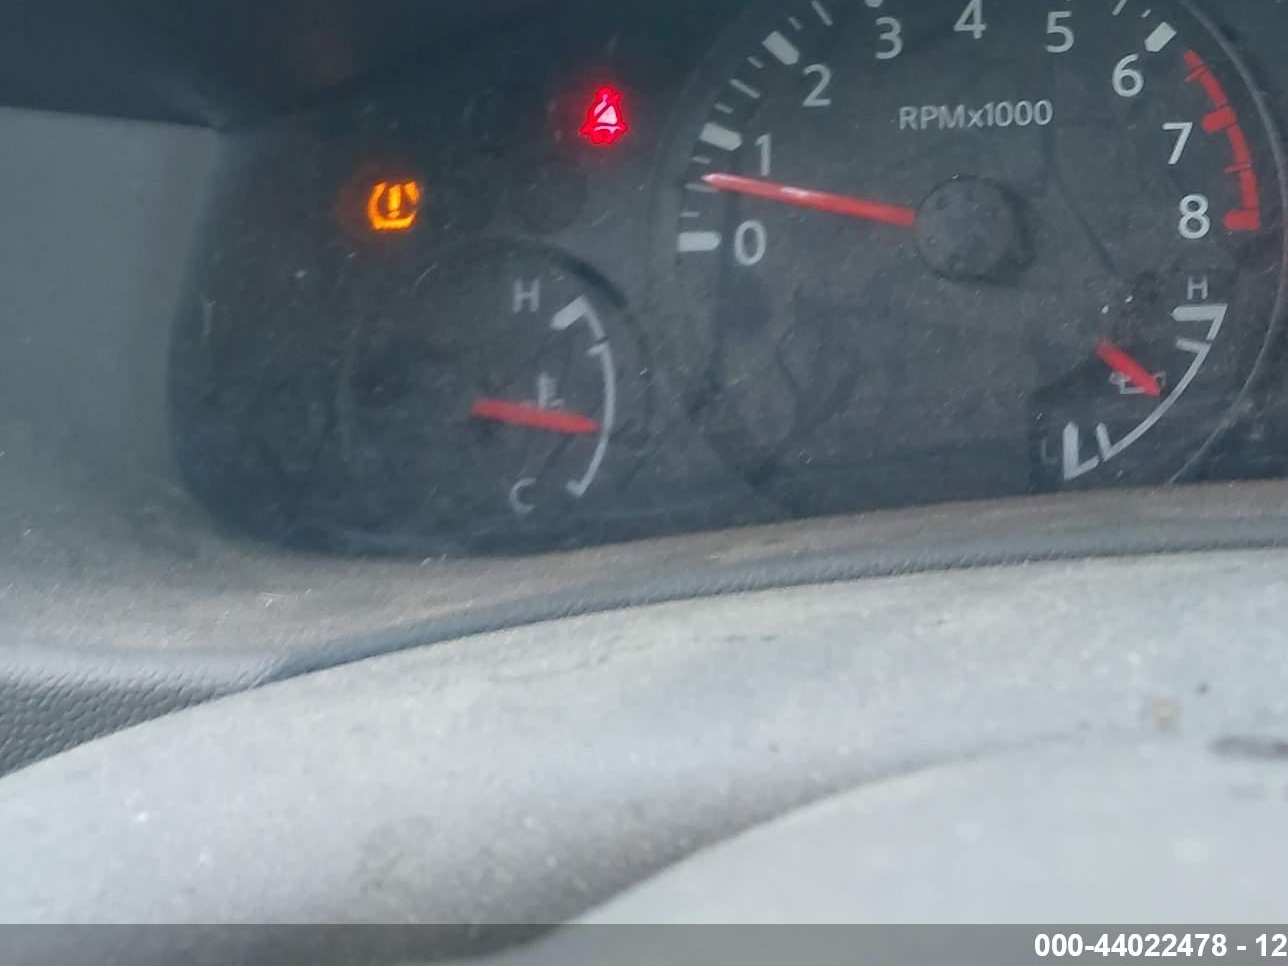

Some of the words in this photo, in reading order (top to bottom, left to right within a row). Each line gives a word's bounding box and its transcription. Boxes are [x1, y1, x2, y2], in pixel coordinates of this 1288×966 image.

[875, 16, 903, 60] 3
[1046, 11, 1075, 53] 5
[802, 64, 832, 107] 2
[1112, 54, 1144, 97] 6
[899, 99, 1053, 131] RPMx1000
[755, 134, 772, 176] 1
[1162, 121, 1194, 165] 7
[1177, 195, 1211, 239] 8
[733, 221, 767, 266] 0
[512, 278, 540, 314] H
[1187, 277, 1209, 300] H
[509, 476, 536, 514] C
